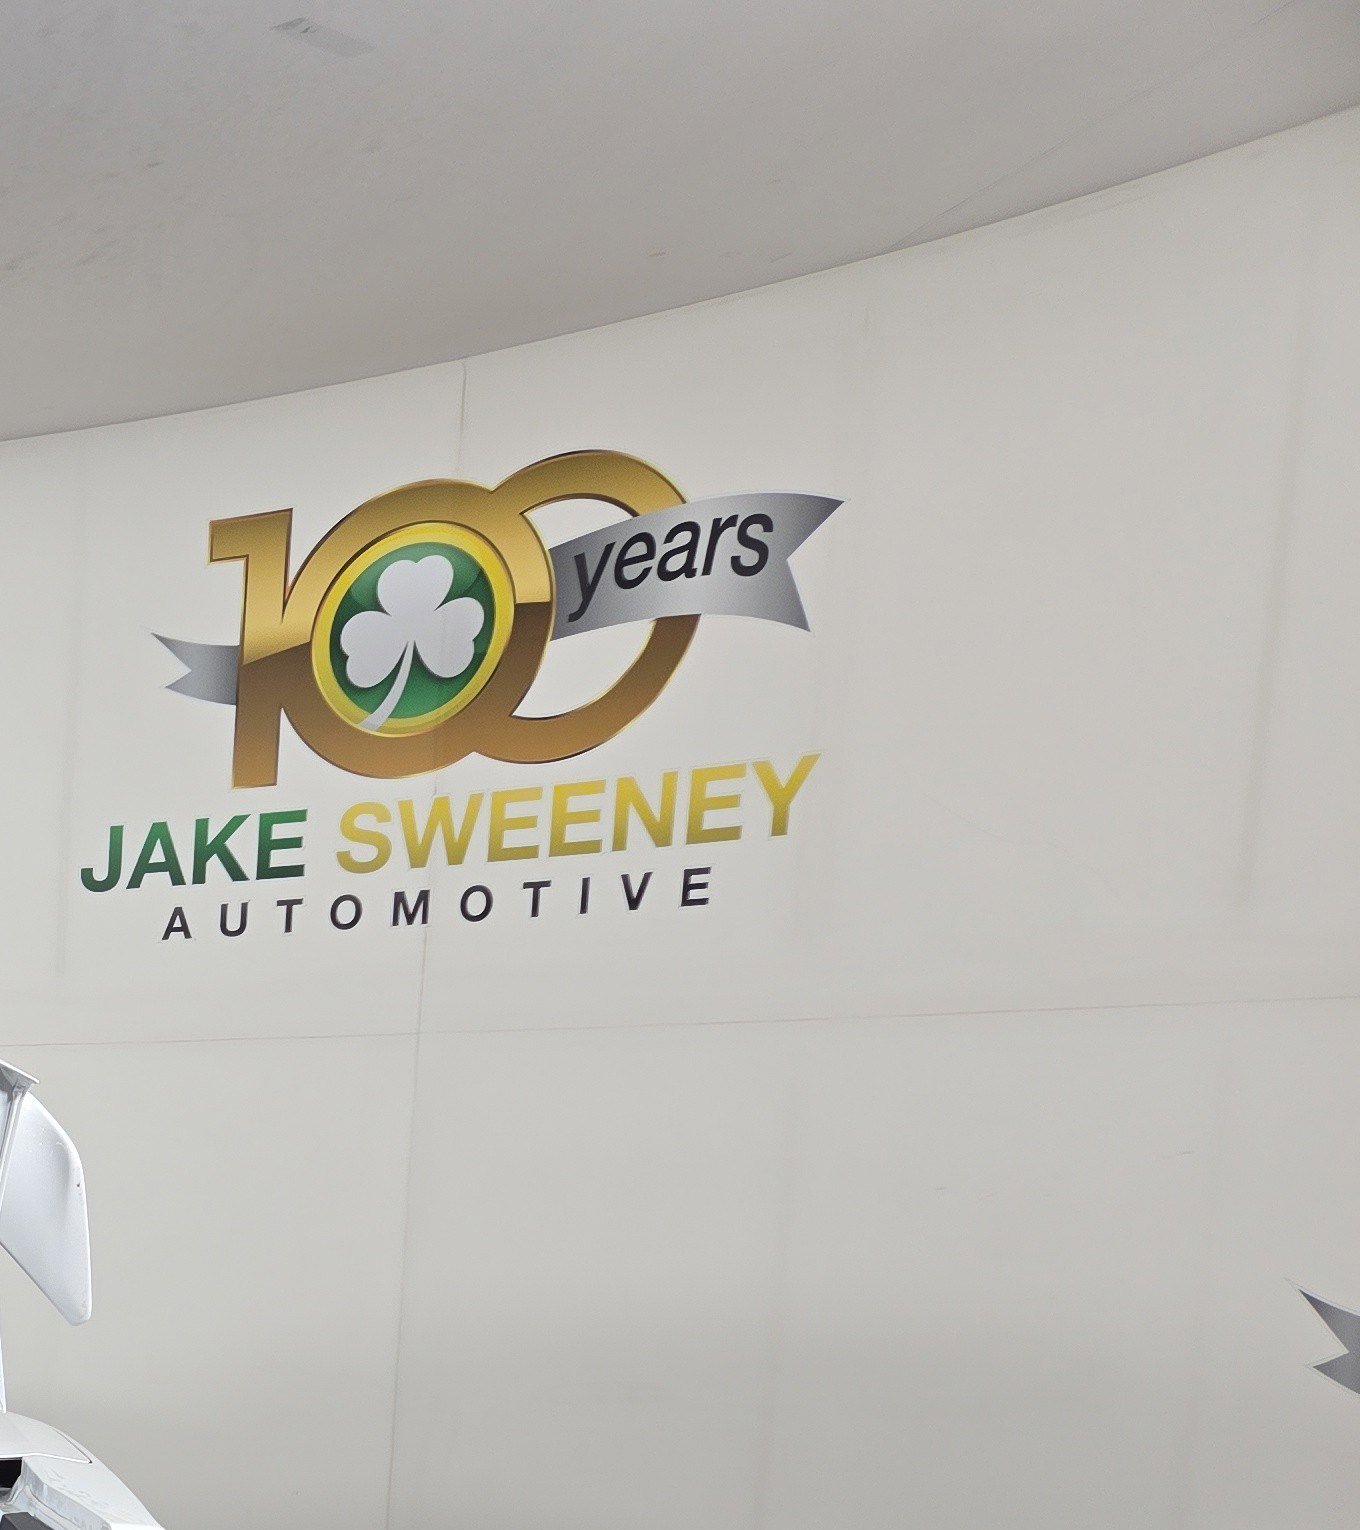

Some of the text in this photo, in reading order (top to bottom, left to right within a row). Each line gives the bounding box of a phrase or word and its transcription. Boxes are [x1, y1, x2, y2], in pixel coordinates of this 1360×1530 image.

[208, 448, 702, 790] 100
[568, 512, 774, 623] years
[79, 753, 822, 894] JAKE SWEENEY
[160, 866, 713, 942] AUTOMOTIVE
